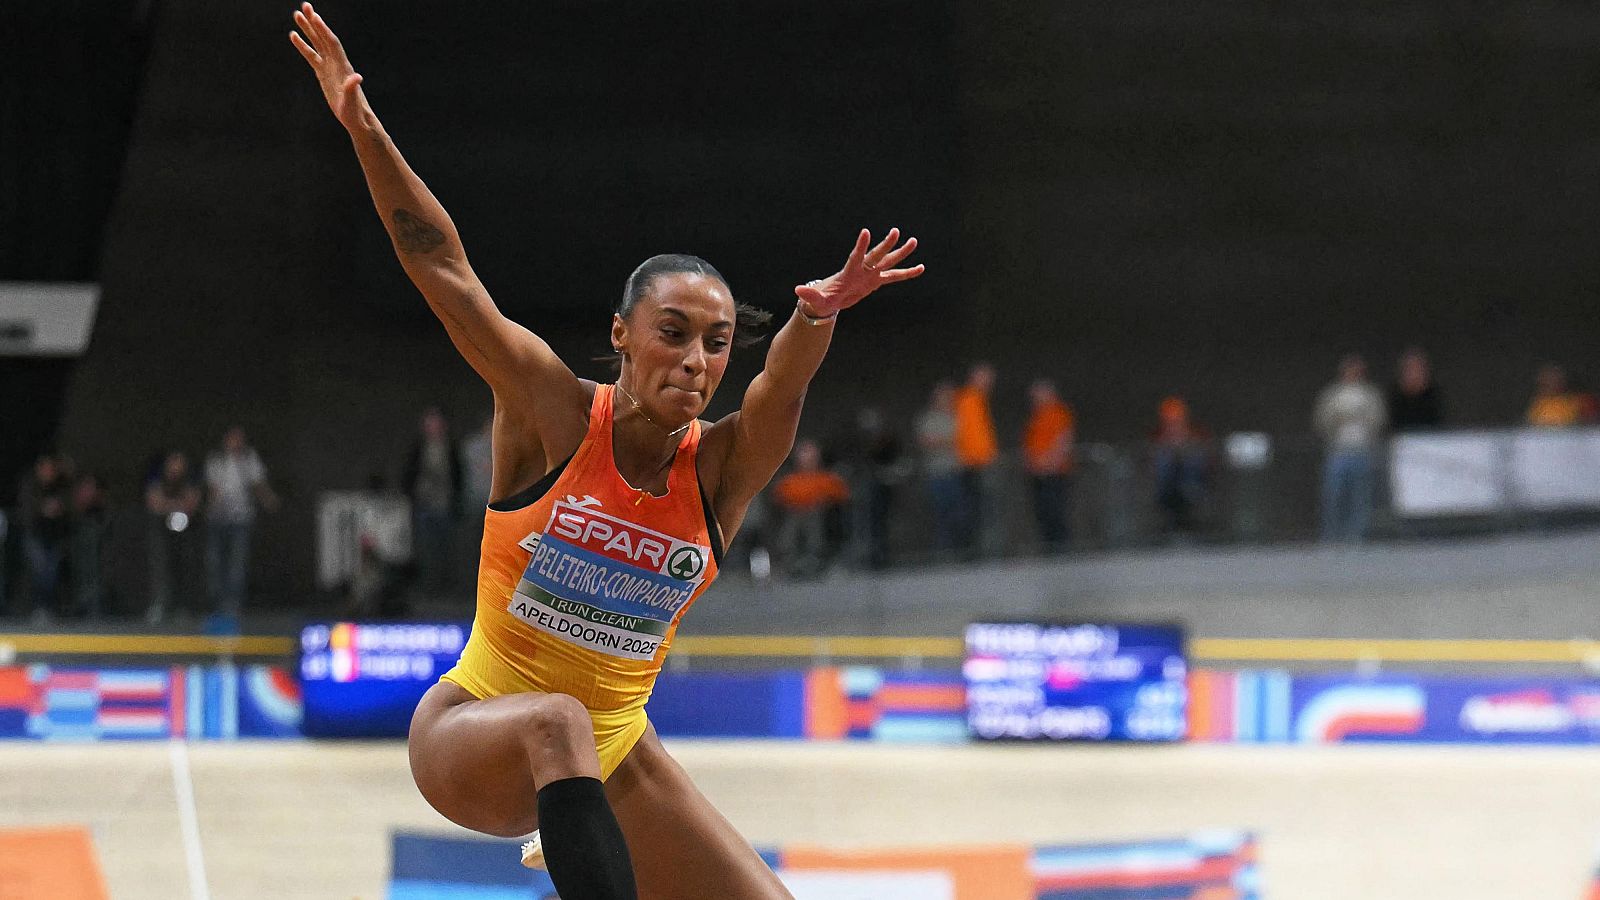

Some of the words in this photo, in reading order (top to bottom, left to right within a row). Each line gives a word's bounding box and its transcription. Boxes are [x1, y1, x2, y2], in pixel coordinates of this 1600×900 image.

[555, 513, 665, 567] SPAR
[530, 543, 690, 612] PELETEIRO-COMPAORÉ
[516, 602, 620, 648] APELDOORN
[622, 638, 657, 654] 2025
[550, 598, 556, 607] I
[558, 602, 590, 616] RUN
